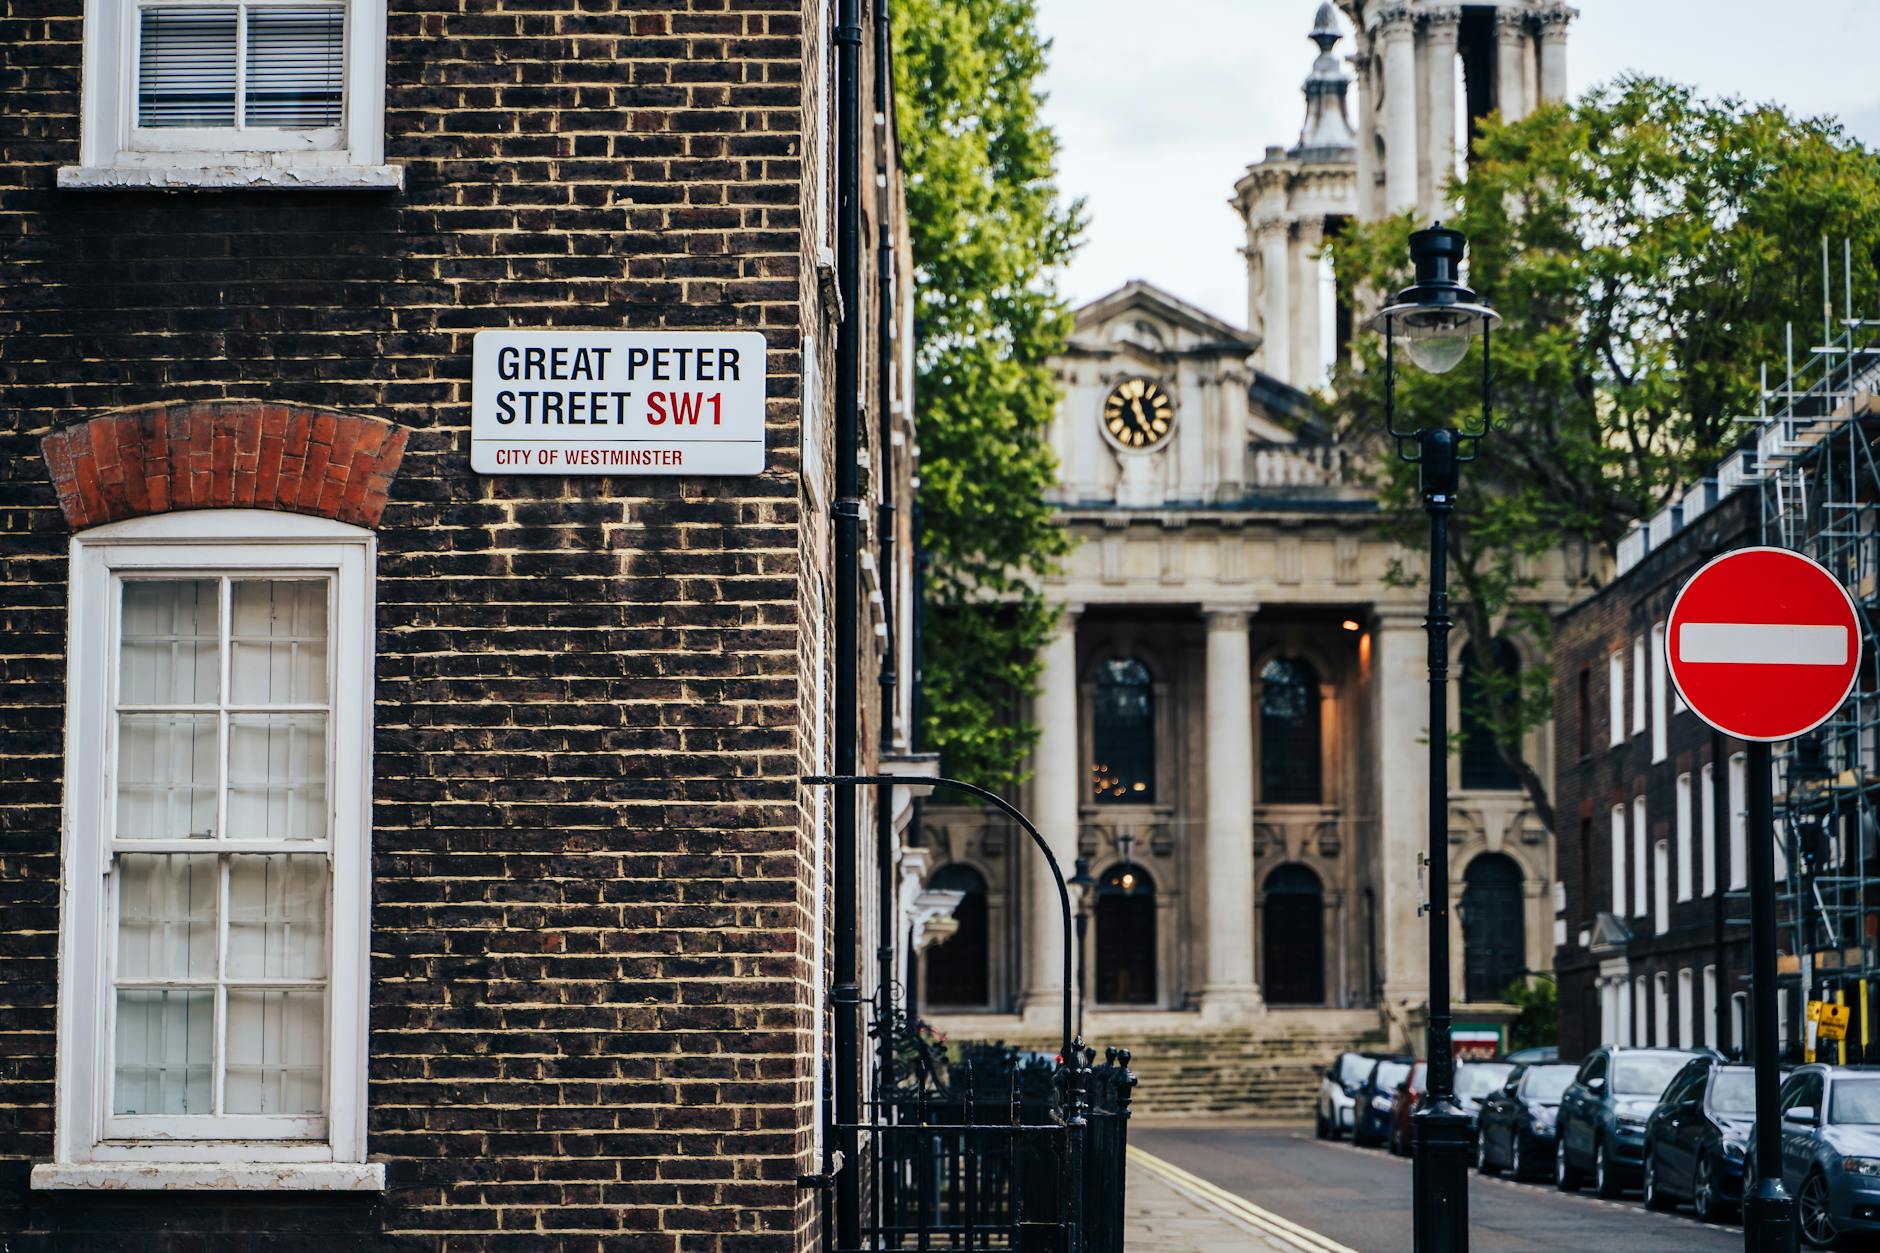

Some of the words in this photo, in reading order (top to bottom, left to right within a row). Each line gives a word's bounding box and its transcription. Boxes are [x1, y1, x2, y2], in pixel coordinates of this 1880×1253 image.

[498, 347, 612, 381] GREAT
[627, 348, 740, 381] PETER
[496, 391, 632, 425] STREET
[646, 391, 722, 426] SW1
[496, 449, 532, 465] CITY
[538, 449, 559, 465] OF
[564, 449, 683, 466] WESTMINSTER
